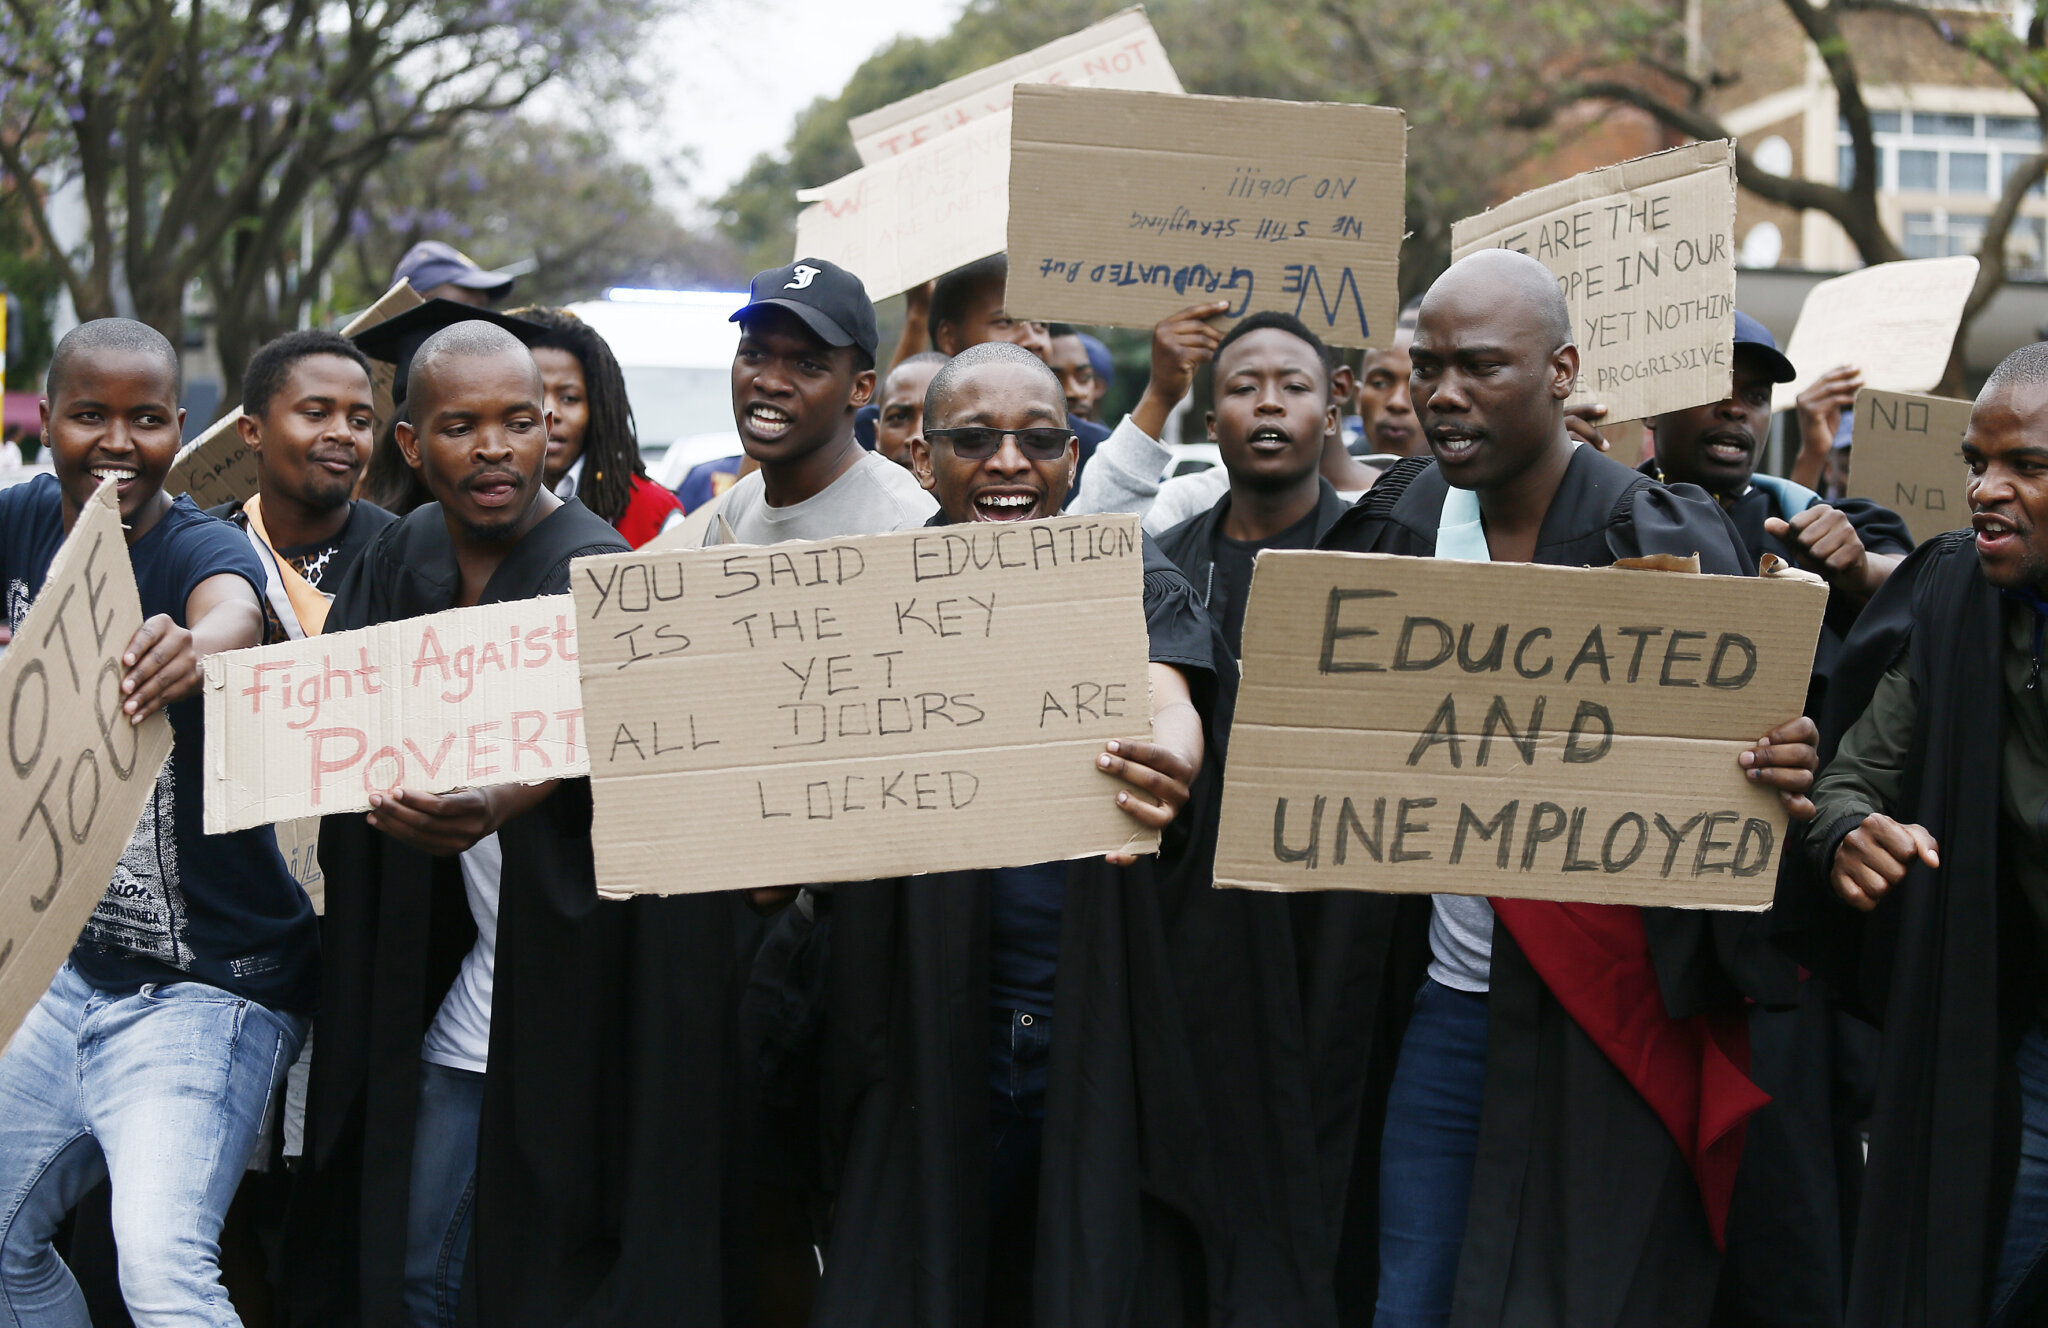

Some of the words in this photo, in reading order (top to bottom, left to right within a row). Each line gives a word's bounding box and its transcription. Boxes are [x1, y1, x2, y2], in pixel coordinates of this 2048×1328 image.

[1083, 40, 1148, 76] NOT
[1314, 177, 1357, 199] NO
[1332, 215, 1363, 240] WE
[1497, 231, 1529, 254] E
[1537, 211, 1593, 262] ARE
[1604, 195, 1671, 240] THE
[1557, 265, 1604, 300] OPE
[1614, 246, 1660, 292] IN
[1674, 233, 1725, 272] OUR
[1281, 264, 1370, 339] WE
[1585, 311, 1638, 351] YET
[1646, 293, 1734, 335] NOTHIN
[1598, 342, 1725, 391] PROGRISSIVE
[1871, 397, 1929, 435] NO
[1895, 482, 1945, 510] NO
[586, 562, 684, 619] YOU
[715, 545, 865, 600] SAID
[914, 521, 1135, 583] EDUCATION
[9, 532, 115, 780] OTE
[615, 624, 692, 670] IS
[732, 607, 842, 648] THE
[897, 593, 996, 638] KEY
[1317, 584, 1758, 691] EDUCATED
[241, 646, 383, 729] Fight
[782, 651, 905, 700] YET
[609, 715, 720, 762] ALL
[773, 691, 985, 750] DOORS
[1039, 683, 1127, 728] ARE
[1406, 692, 1616, 769] AND
[759, 770, 980, 820] LOCKED
[1272, 794, 1775, 878] UNEMPLOYED
